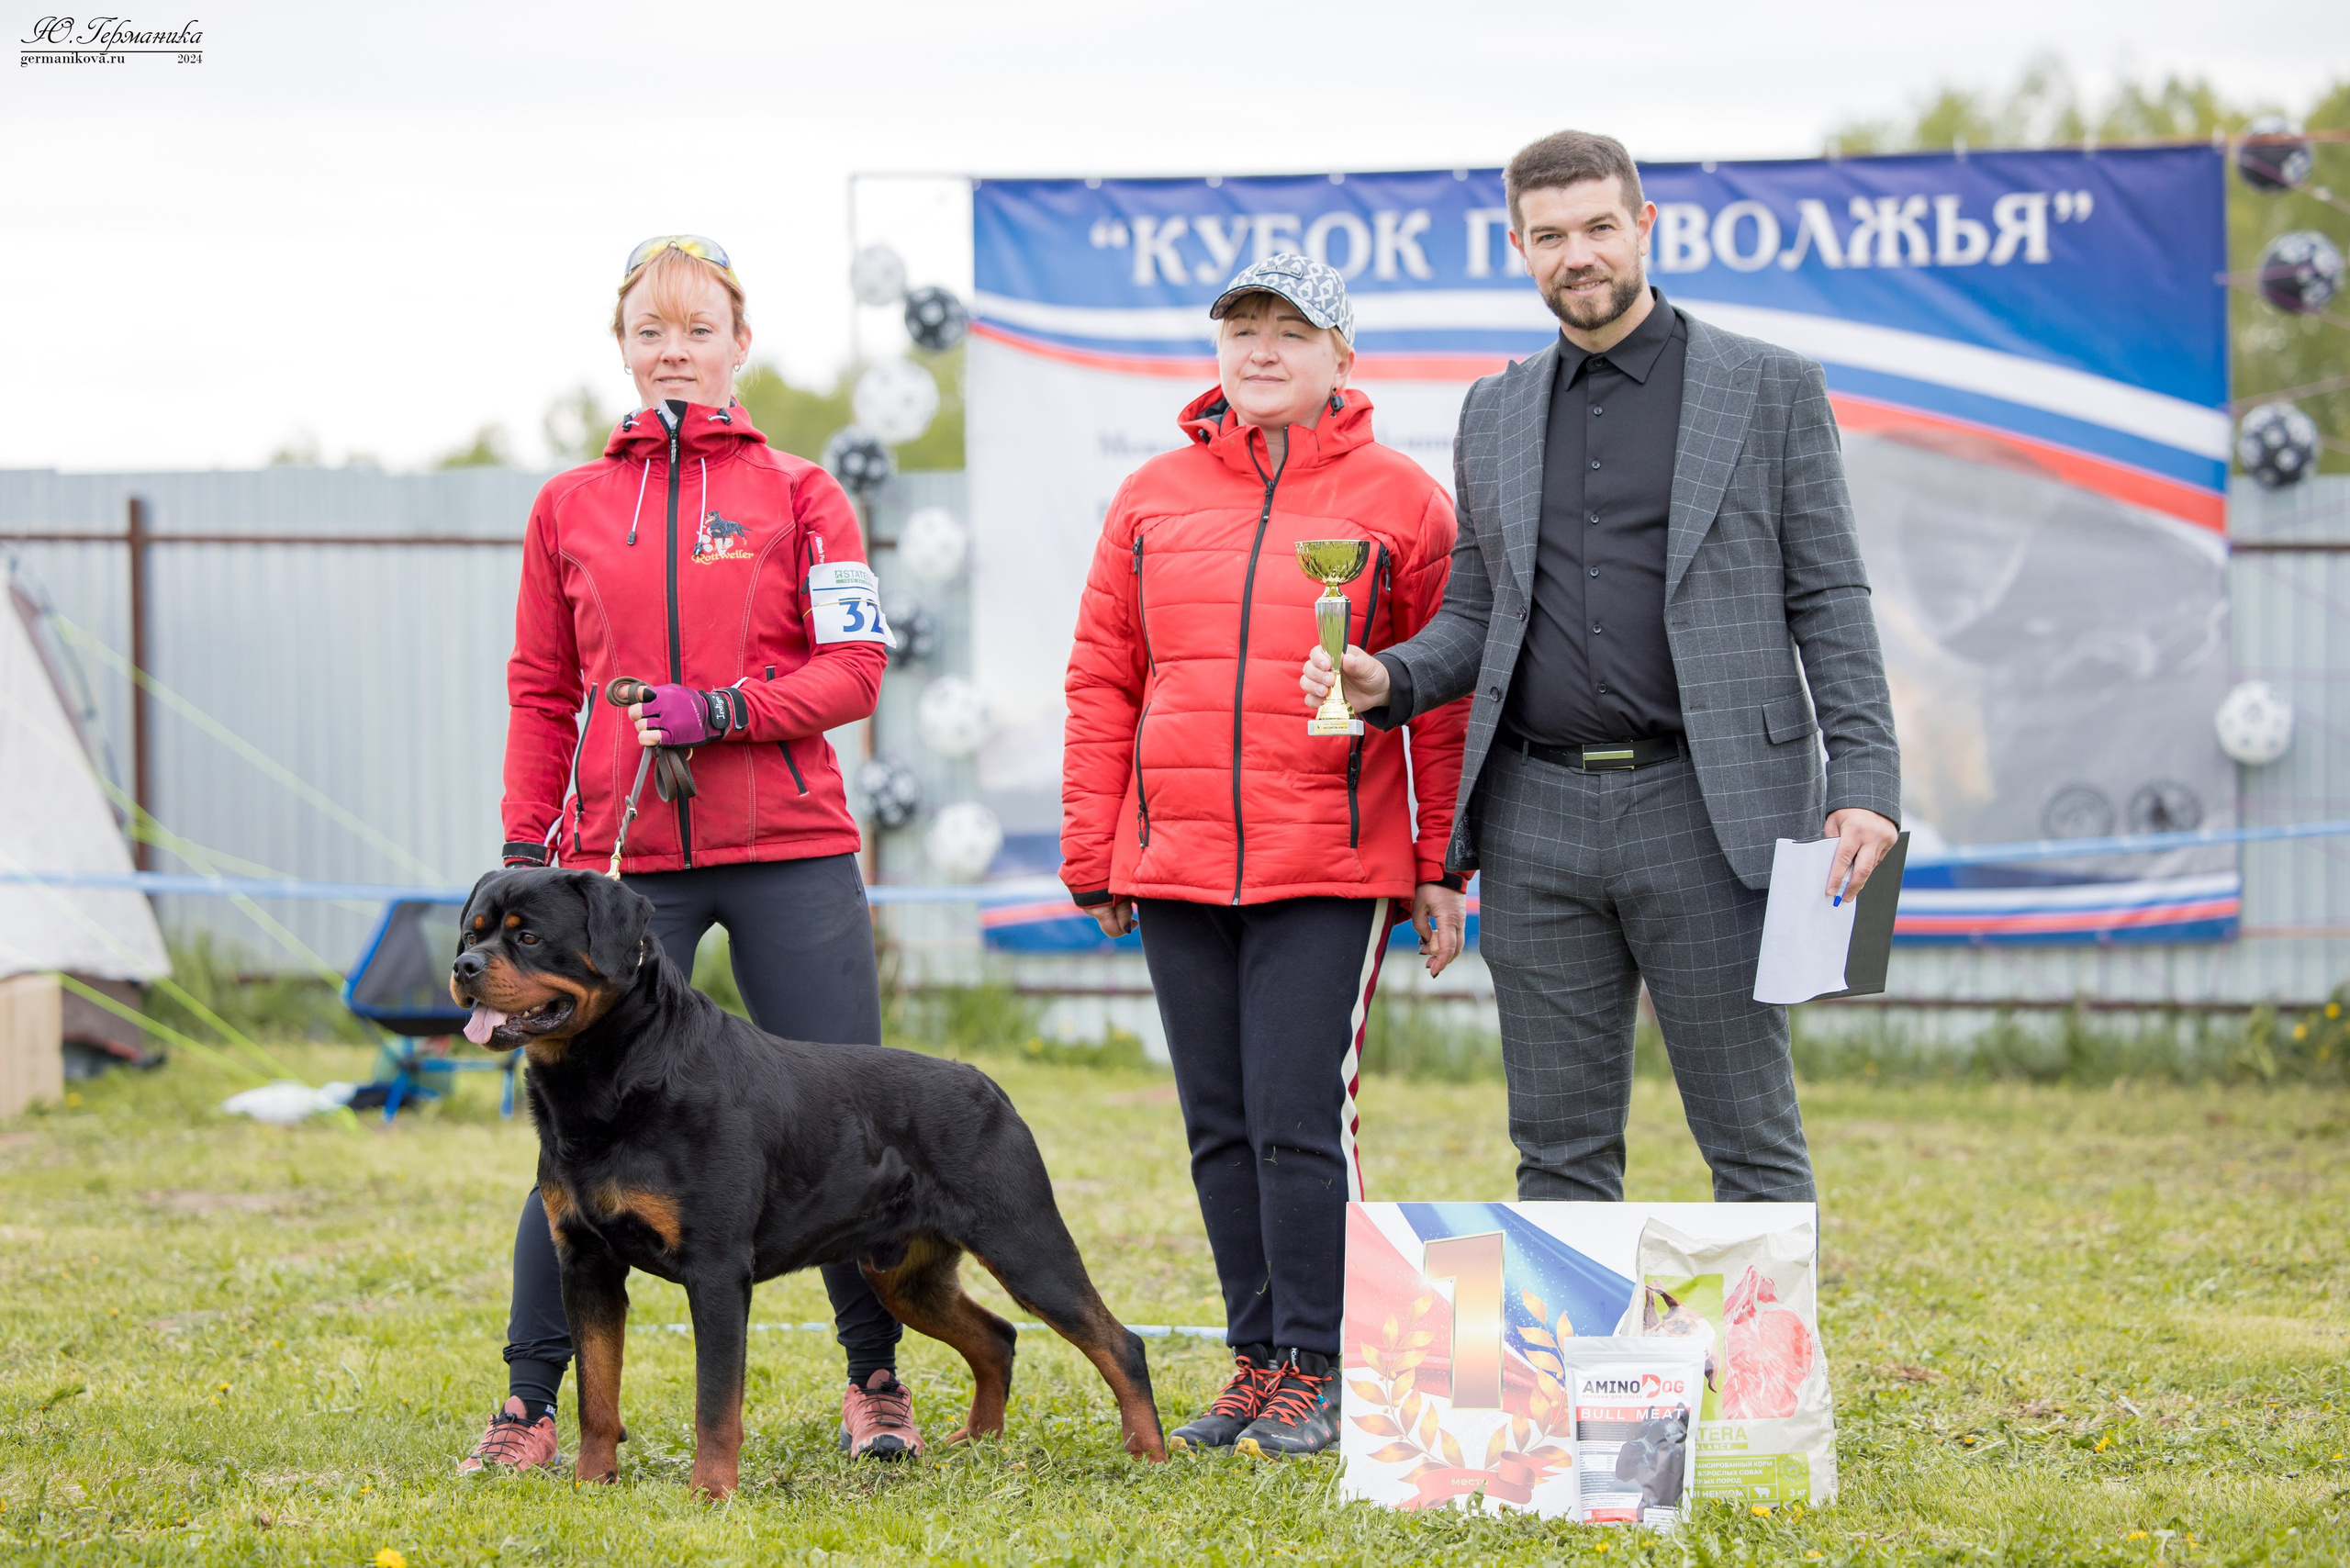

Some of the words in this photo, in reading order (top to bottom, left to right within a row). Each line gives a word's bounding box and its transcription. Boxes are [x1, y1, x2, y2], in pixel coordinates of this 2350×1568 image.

[1464, 189, 2093, 281] ПВОЛЖЬЯ”
[691, 549, 755, 565] Rottweiler
[838, 597, 885, 634] 32
[714, 696, 726, 720] Indigo
[1424, 1230, 1506, 1411] 1
[1581, 1408, 1625, 1420] BULL
[1636, 1408, 1684, 1419] MEAT
[1695, 1426, 1748, 1441] TERA
[1789, 1488, 1796, 1496] 3
